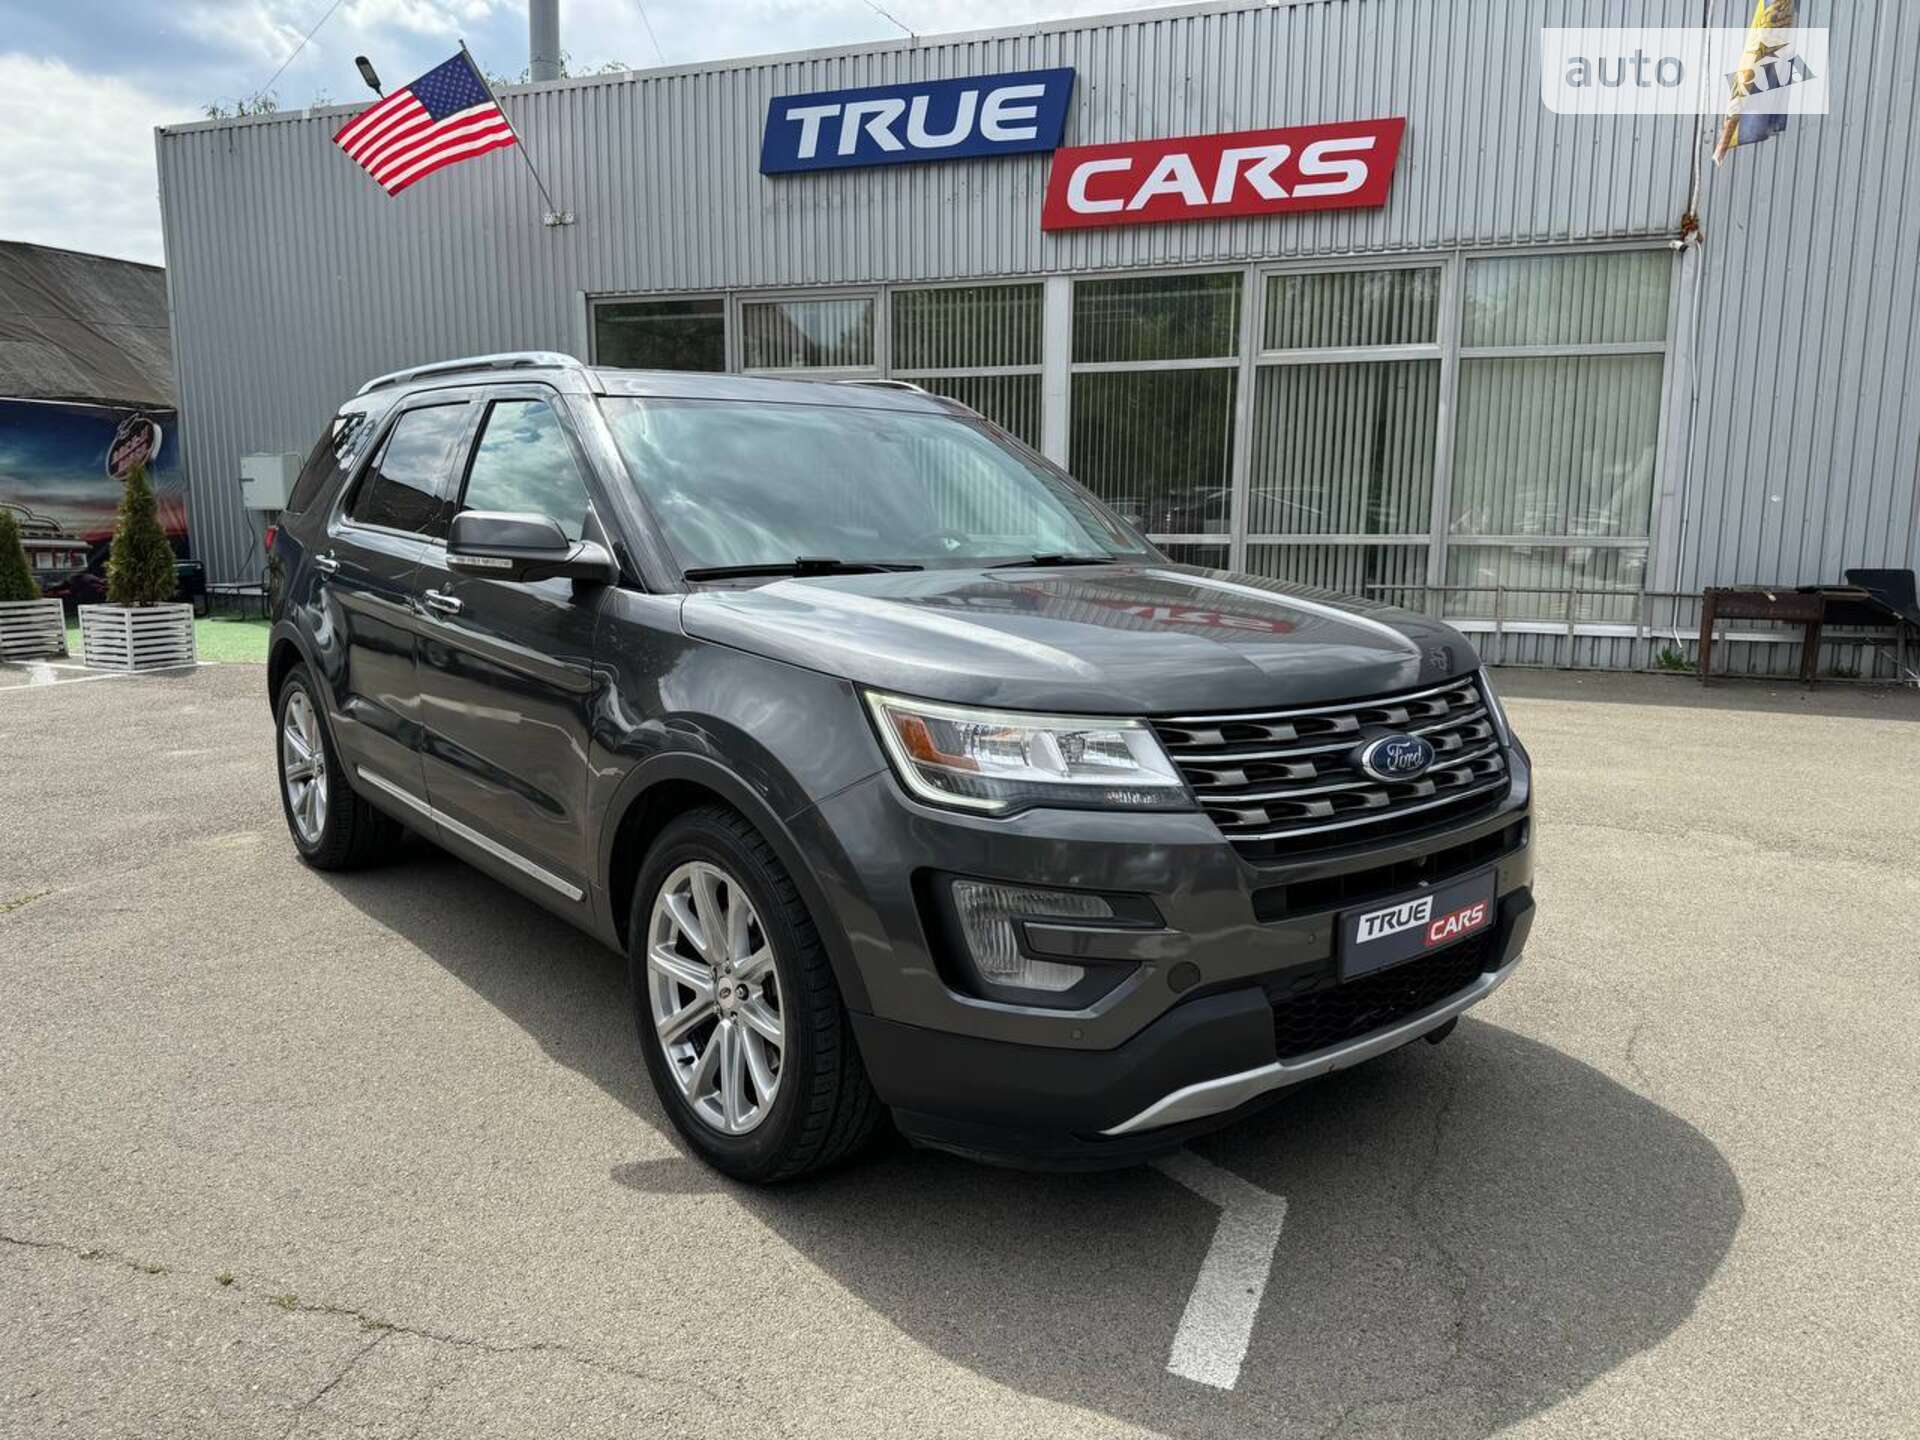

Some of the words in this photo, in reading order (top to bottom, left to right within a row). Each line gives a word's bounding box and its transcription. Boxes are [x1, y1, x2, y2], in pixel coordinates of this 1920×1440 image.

[786, 83, 1045, 159] TRUE
[1065, 136, 1377, 213] CARS
[1387, 742, 1424, 771] Ford
[1365, 902, 1428, 936] TRUE
[1430, 903, 1485, 941] CARS
